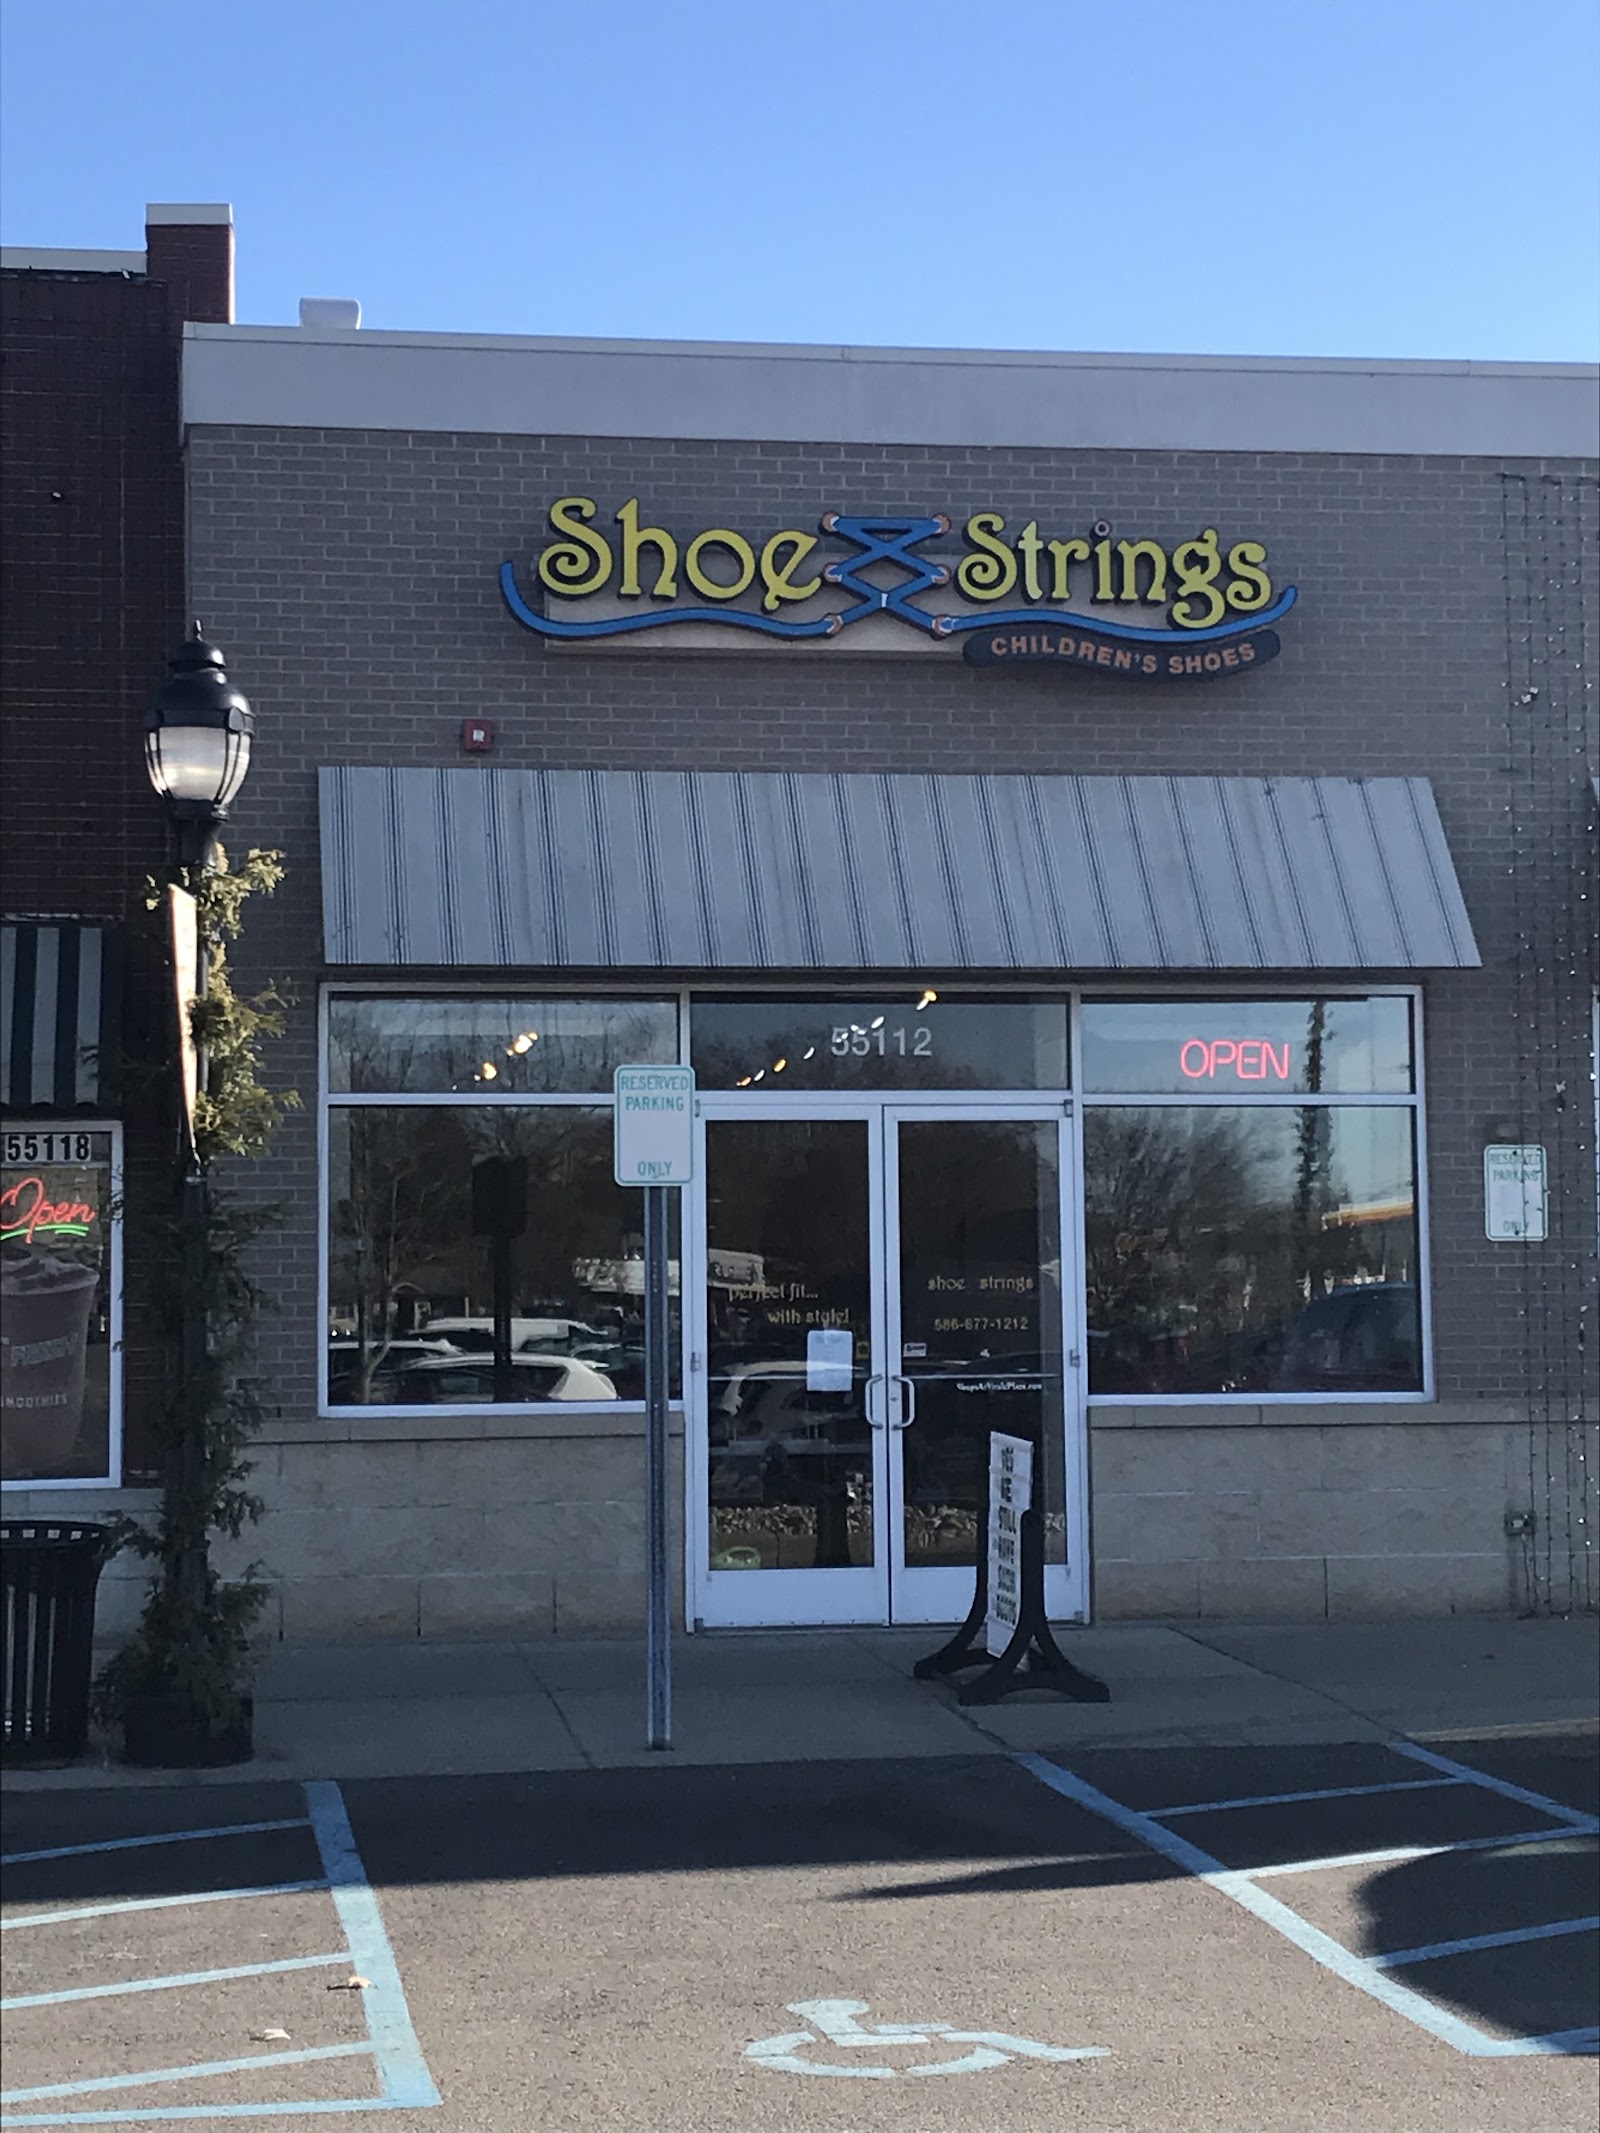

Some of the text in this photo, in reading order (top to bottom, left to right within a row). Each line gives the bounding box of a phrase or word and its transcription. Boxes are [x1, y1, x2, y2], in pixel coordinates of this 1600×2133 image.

[538, 497, 1273, 629] Shoe Strings
[991, 634, 1256, 675] CHILDREN'S SHOES
[830, 1026, 933, 1057] 55112
[1180, 1038, 1291, 1079] OPEN
[621, 1075, 689, 1091] RESERVED
[625, 1096, 685, 1112] PARKING
[7, 1134, 91, 1162] 55118
[637, 1160, 672, 1176] ONLY
[0, 1176, 96, 1244] Open
[927, 1275, 1035, 1294] shoe strings
[766, 1308, 801, 1325] with
